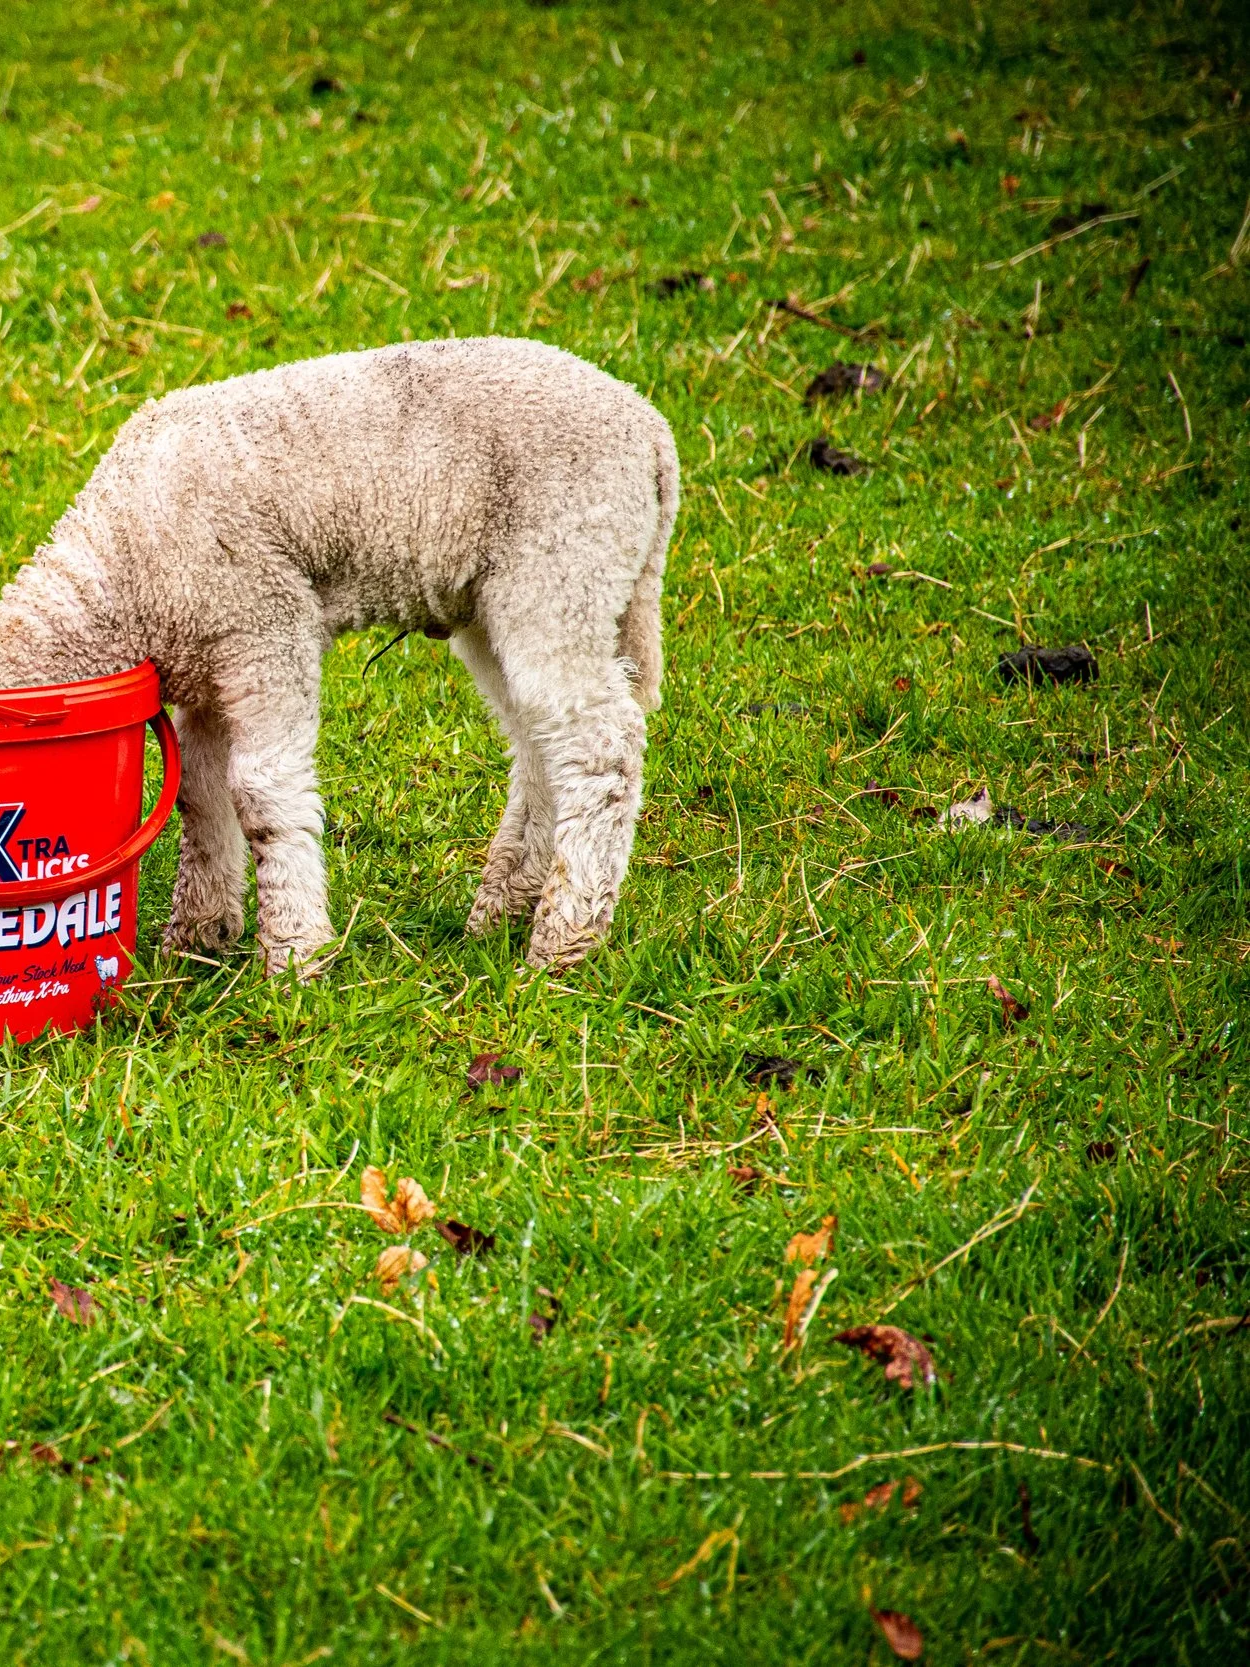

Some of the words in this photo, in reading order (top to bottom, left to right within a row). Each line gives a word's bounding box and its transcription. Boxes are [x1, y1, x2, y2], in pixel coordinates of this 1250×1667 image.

[21, 854, 90, 882] LICKS
[22, 962, 57, 982] Stock
[35, 981, 70, 1000] X-tra
